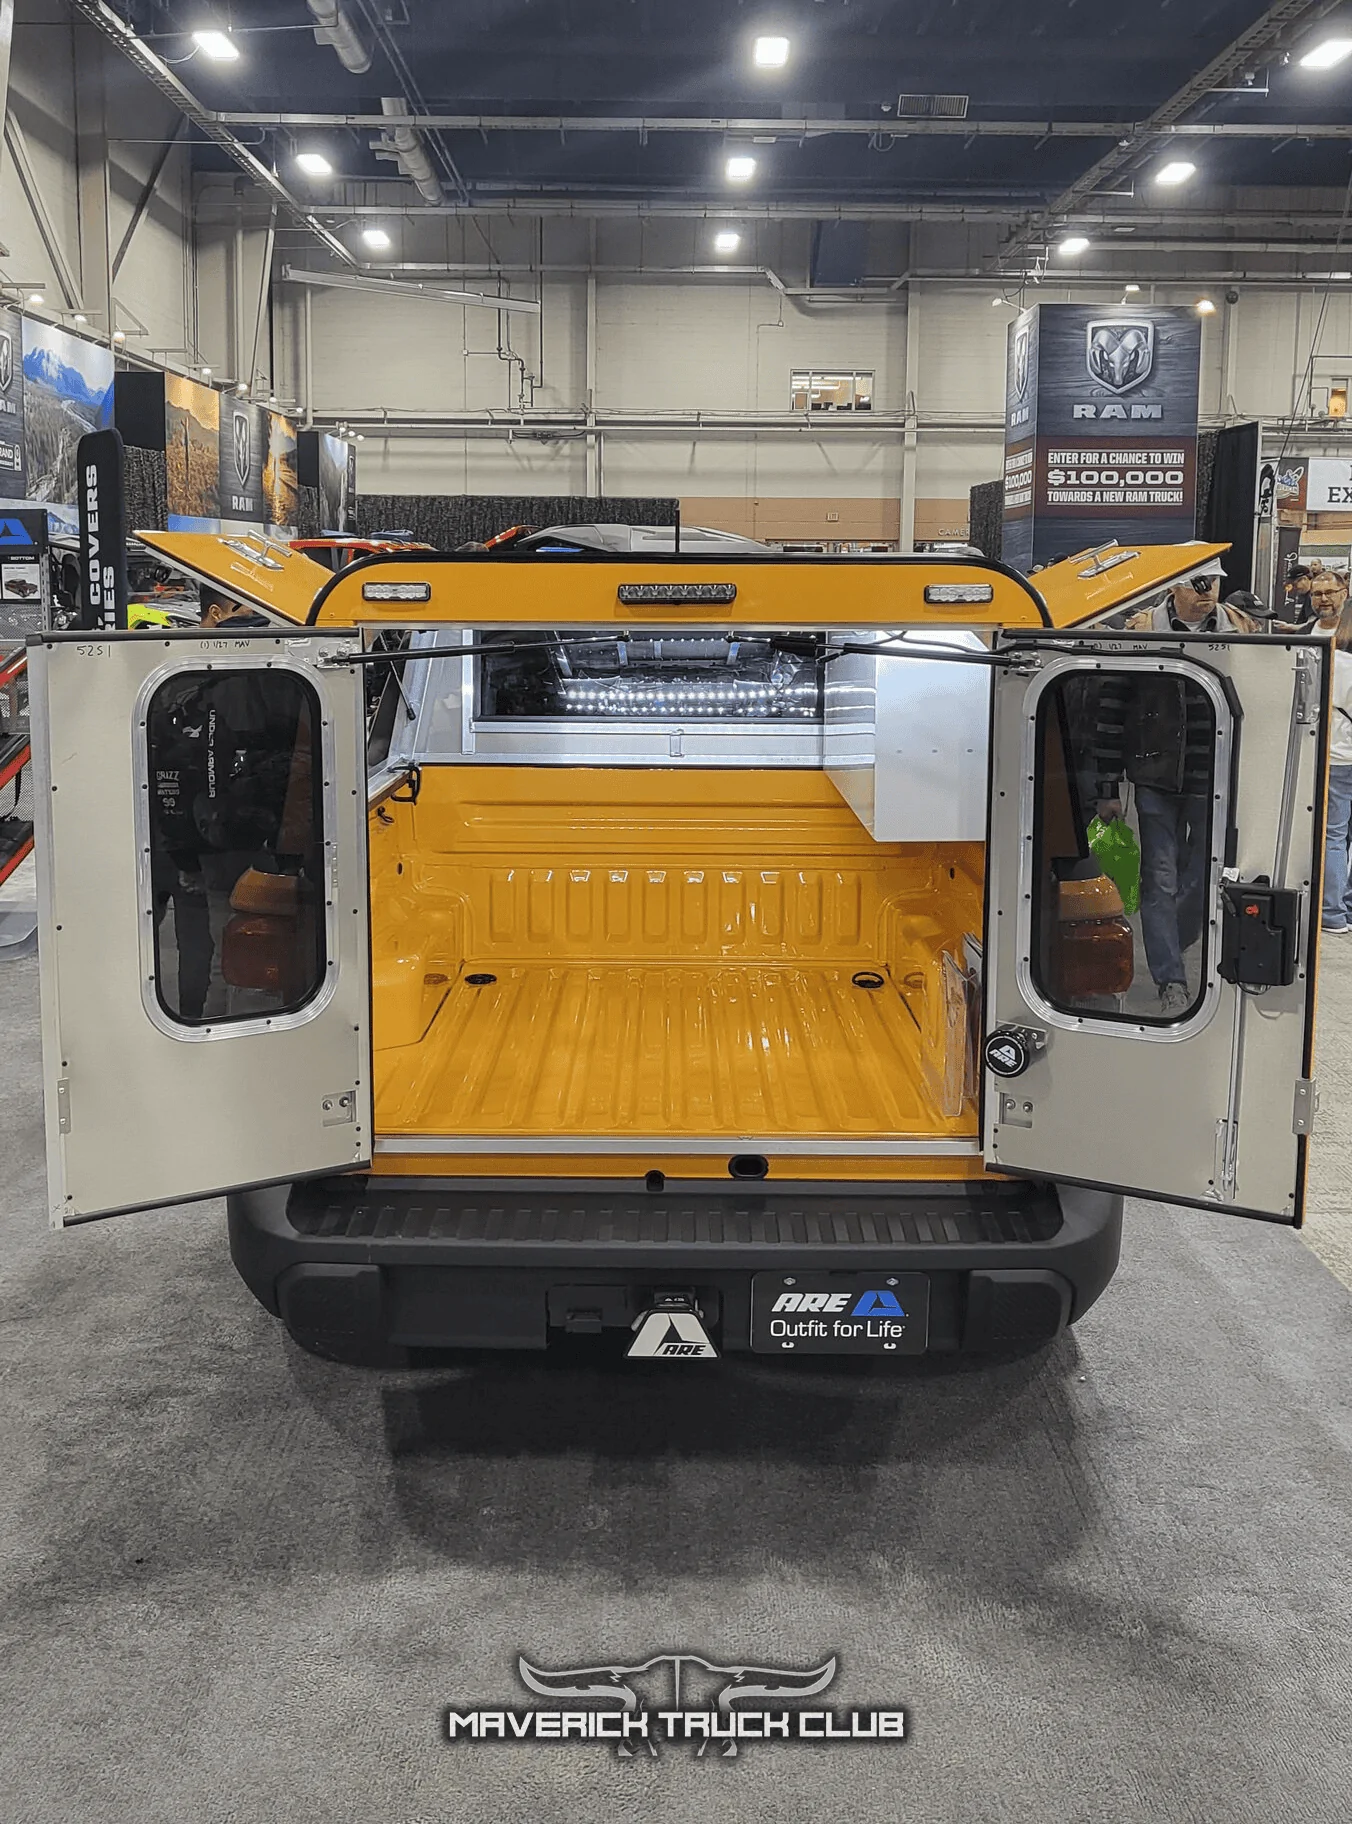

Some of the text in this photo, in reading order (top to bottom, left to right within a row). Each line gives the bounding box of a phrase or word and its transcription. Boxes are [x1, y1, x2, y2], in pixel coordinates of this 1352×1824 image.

[1010, 406, 1029, 427] RAM
[1073, 404, 1162, 419] RAM
[1048, 453, 1185, 464] ENTER FOR A CHANCE TO WIN
[1005, 470, 1032, 491] $100,000
[1047, 469, 1184, 487] $100,000
[231, 495, 254, 512] RAM
[1047, 491, 1183, 502] TOWARDS A NEW RAM TRUCK!
[86, 465, 101, 605] COVERS
[234, 640, 250, 648] MAV
[207, 749, 216, 798] ARMOUR
[771, 1292, 852, 1313] ARE
[770, 1319, 827, 1338] Outfit
[832, 1319, 864, 1338] for
[661, 1344, 706, 1355] ARE
